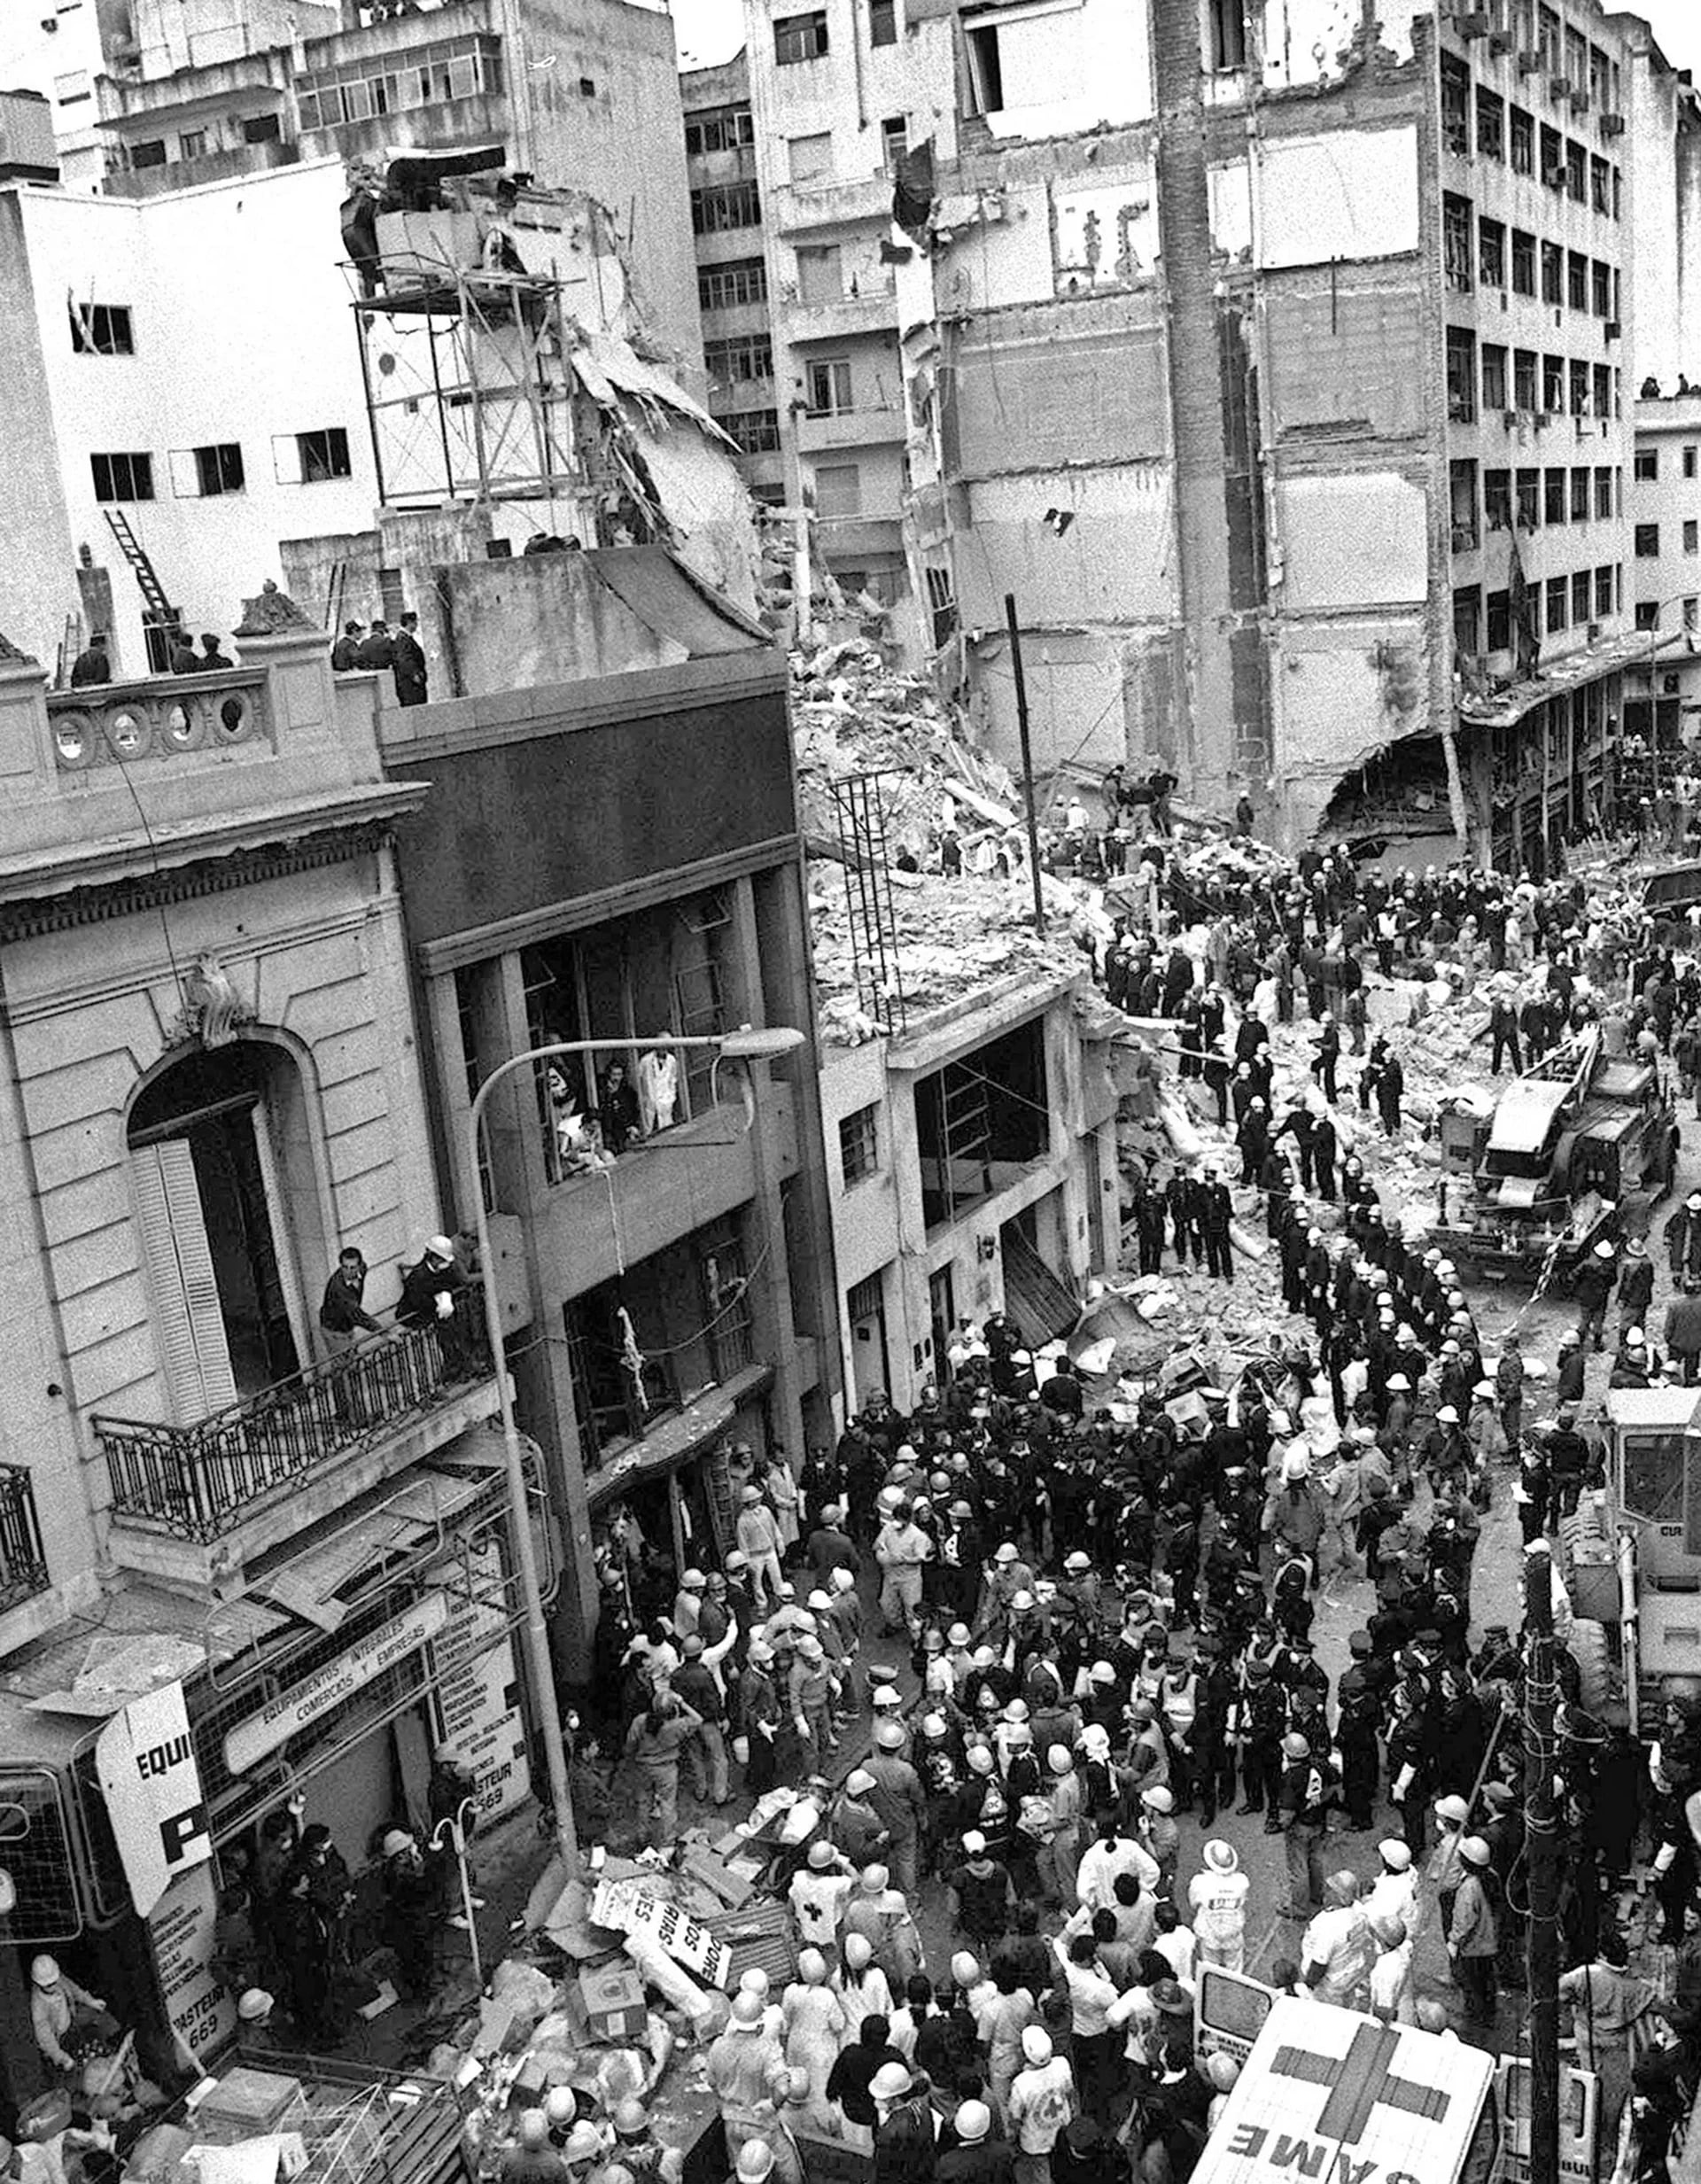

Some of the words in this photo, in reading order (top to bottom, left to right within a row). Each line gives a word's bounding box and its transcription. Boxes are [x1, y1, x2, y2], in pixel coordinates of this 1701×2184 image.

[263, 1663, 340, 1725] EQUIPAMIENTOS
[351, 1620, 405, 1665] INTEGRALES
[295, 1673, 354, 1722] COMERCIOS
[361, 1663, 369, 1676] Y
[377, 1623, 426, 1667] EMPRESAS
[136, 1730, 195, 1780] EQUI
[476, 1761, 512, 1795] STEUR
[684, 1925, 701, 1953] OS
[173, 1984, 226, 2033] PASTEUR
[190, 2014, 218, 2049] 669
